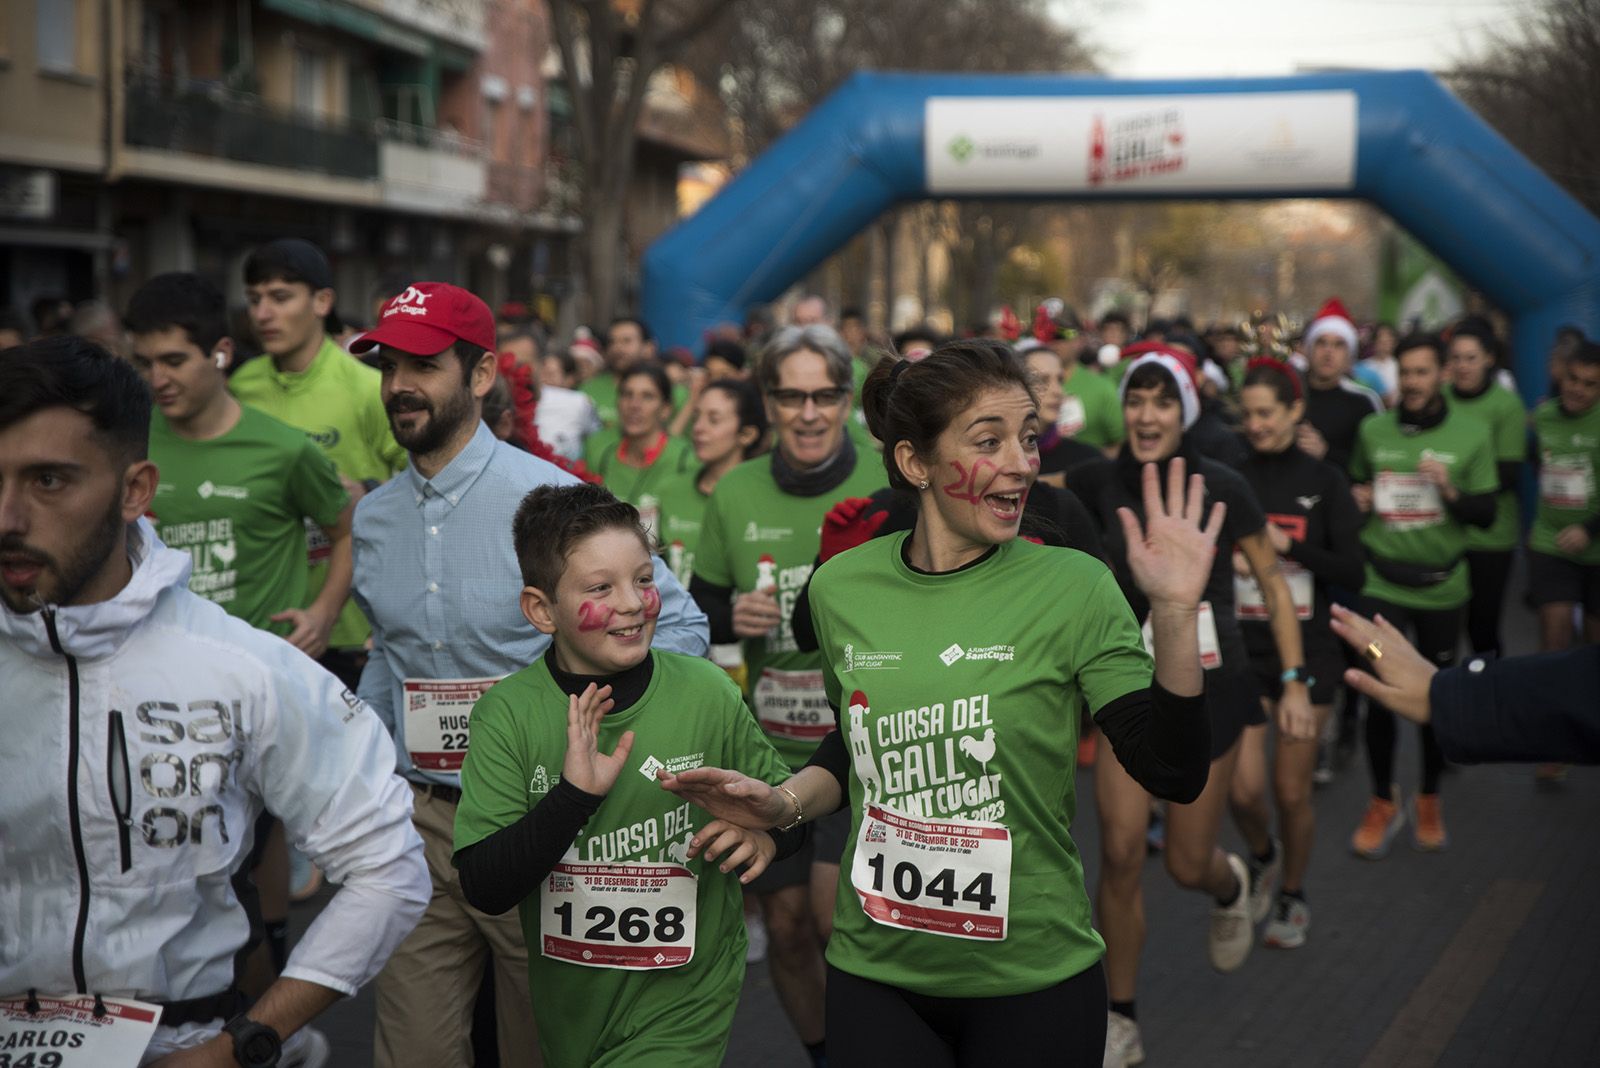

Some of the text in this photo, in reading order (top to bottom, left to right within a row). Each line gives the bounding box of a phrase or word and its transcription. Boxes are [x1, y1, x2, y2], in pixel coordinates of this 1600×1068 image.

[965, 651, 1014, 661] SantCugat
[877, 694, 993, 747] CURSA DEL
[880, 738, 966, 794] GALL
[936, 773, 1002, 814] CUGAT
[588, 801, 693, 863] CURSA DEL
[896, 829, 979, 848] 31 DE DESEMBRE DE 2023
[585, 877, 592, 885] 31
[594, 877, 602, 885] DE
[604, 877, 638, 887] DESEMBRE
[640, 879, 648, 887] DE
[868, 852, 997, 911] 1044
[554, 901, 685, 943] 1268
